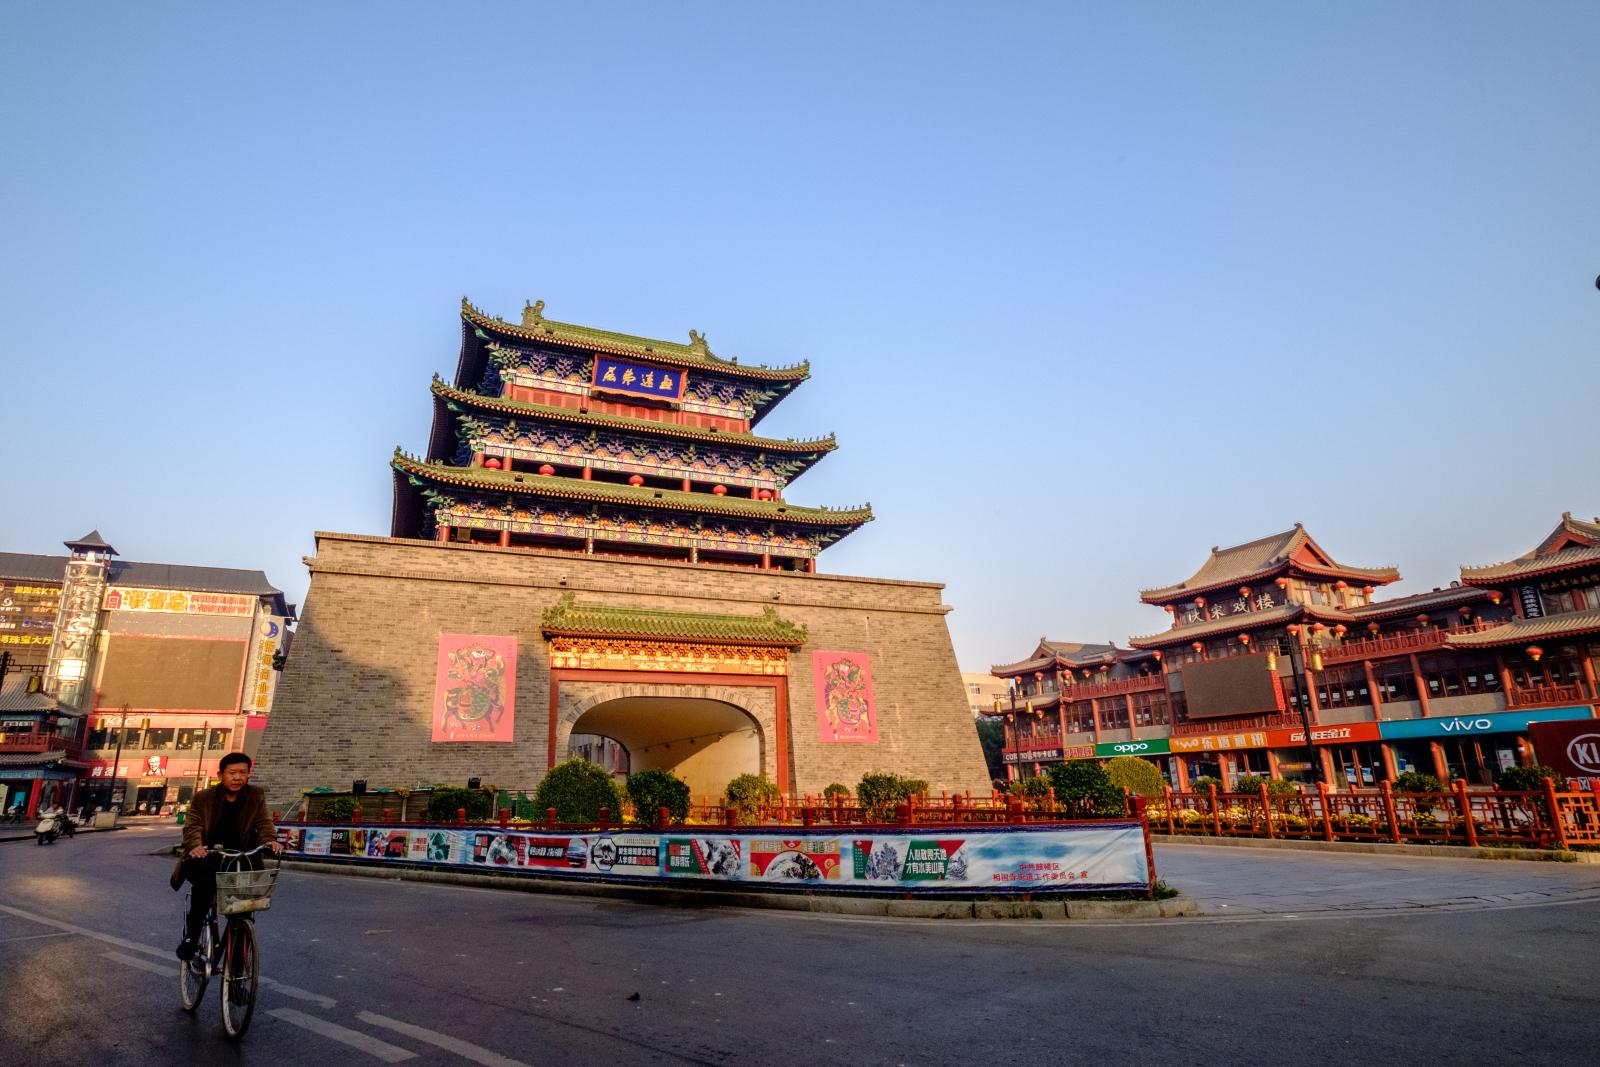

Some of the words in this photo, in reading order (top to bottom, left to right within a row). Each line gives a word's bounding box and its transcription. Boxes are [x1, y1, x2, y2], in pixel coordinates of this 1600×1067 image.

[1440, 718, 1492, 732] vivo
[1575, 742, 1600, 764] KI
[91, 766, 128, 777] 肯德基
